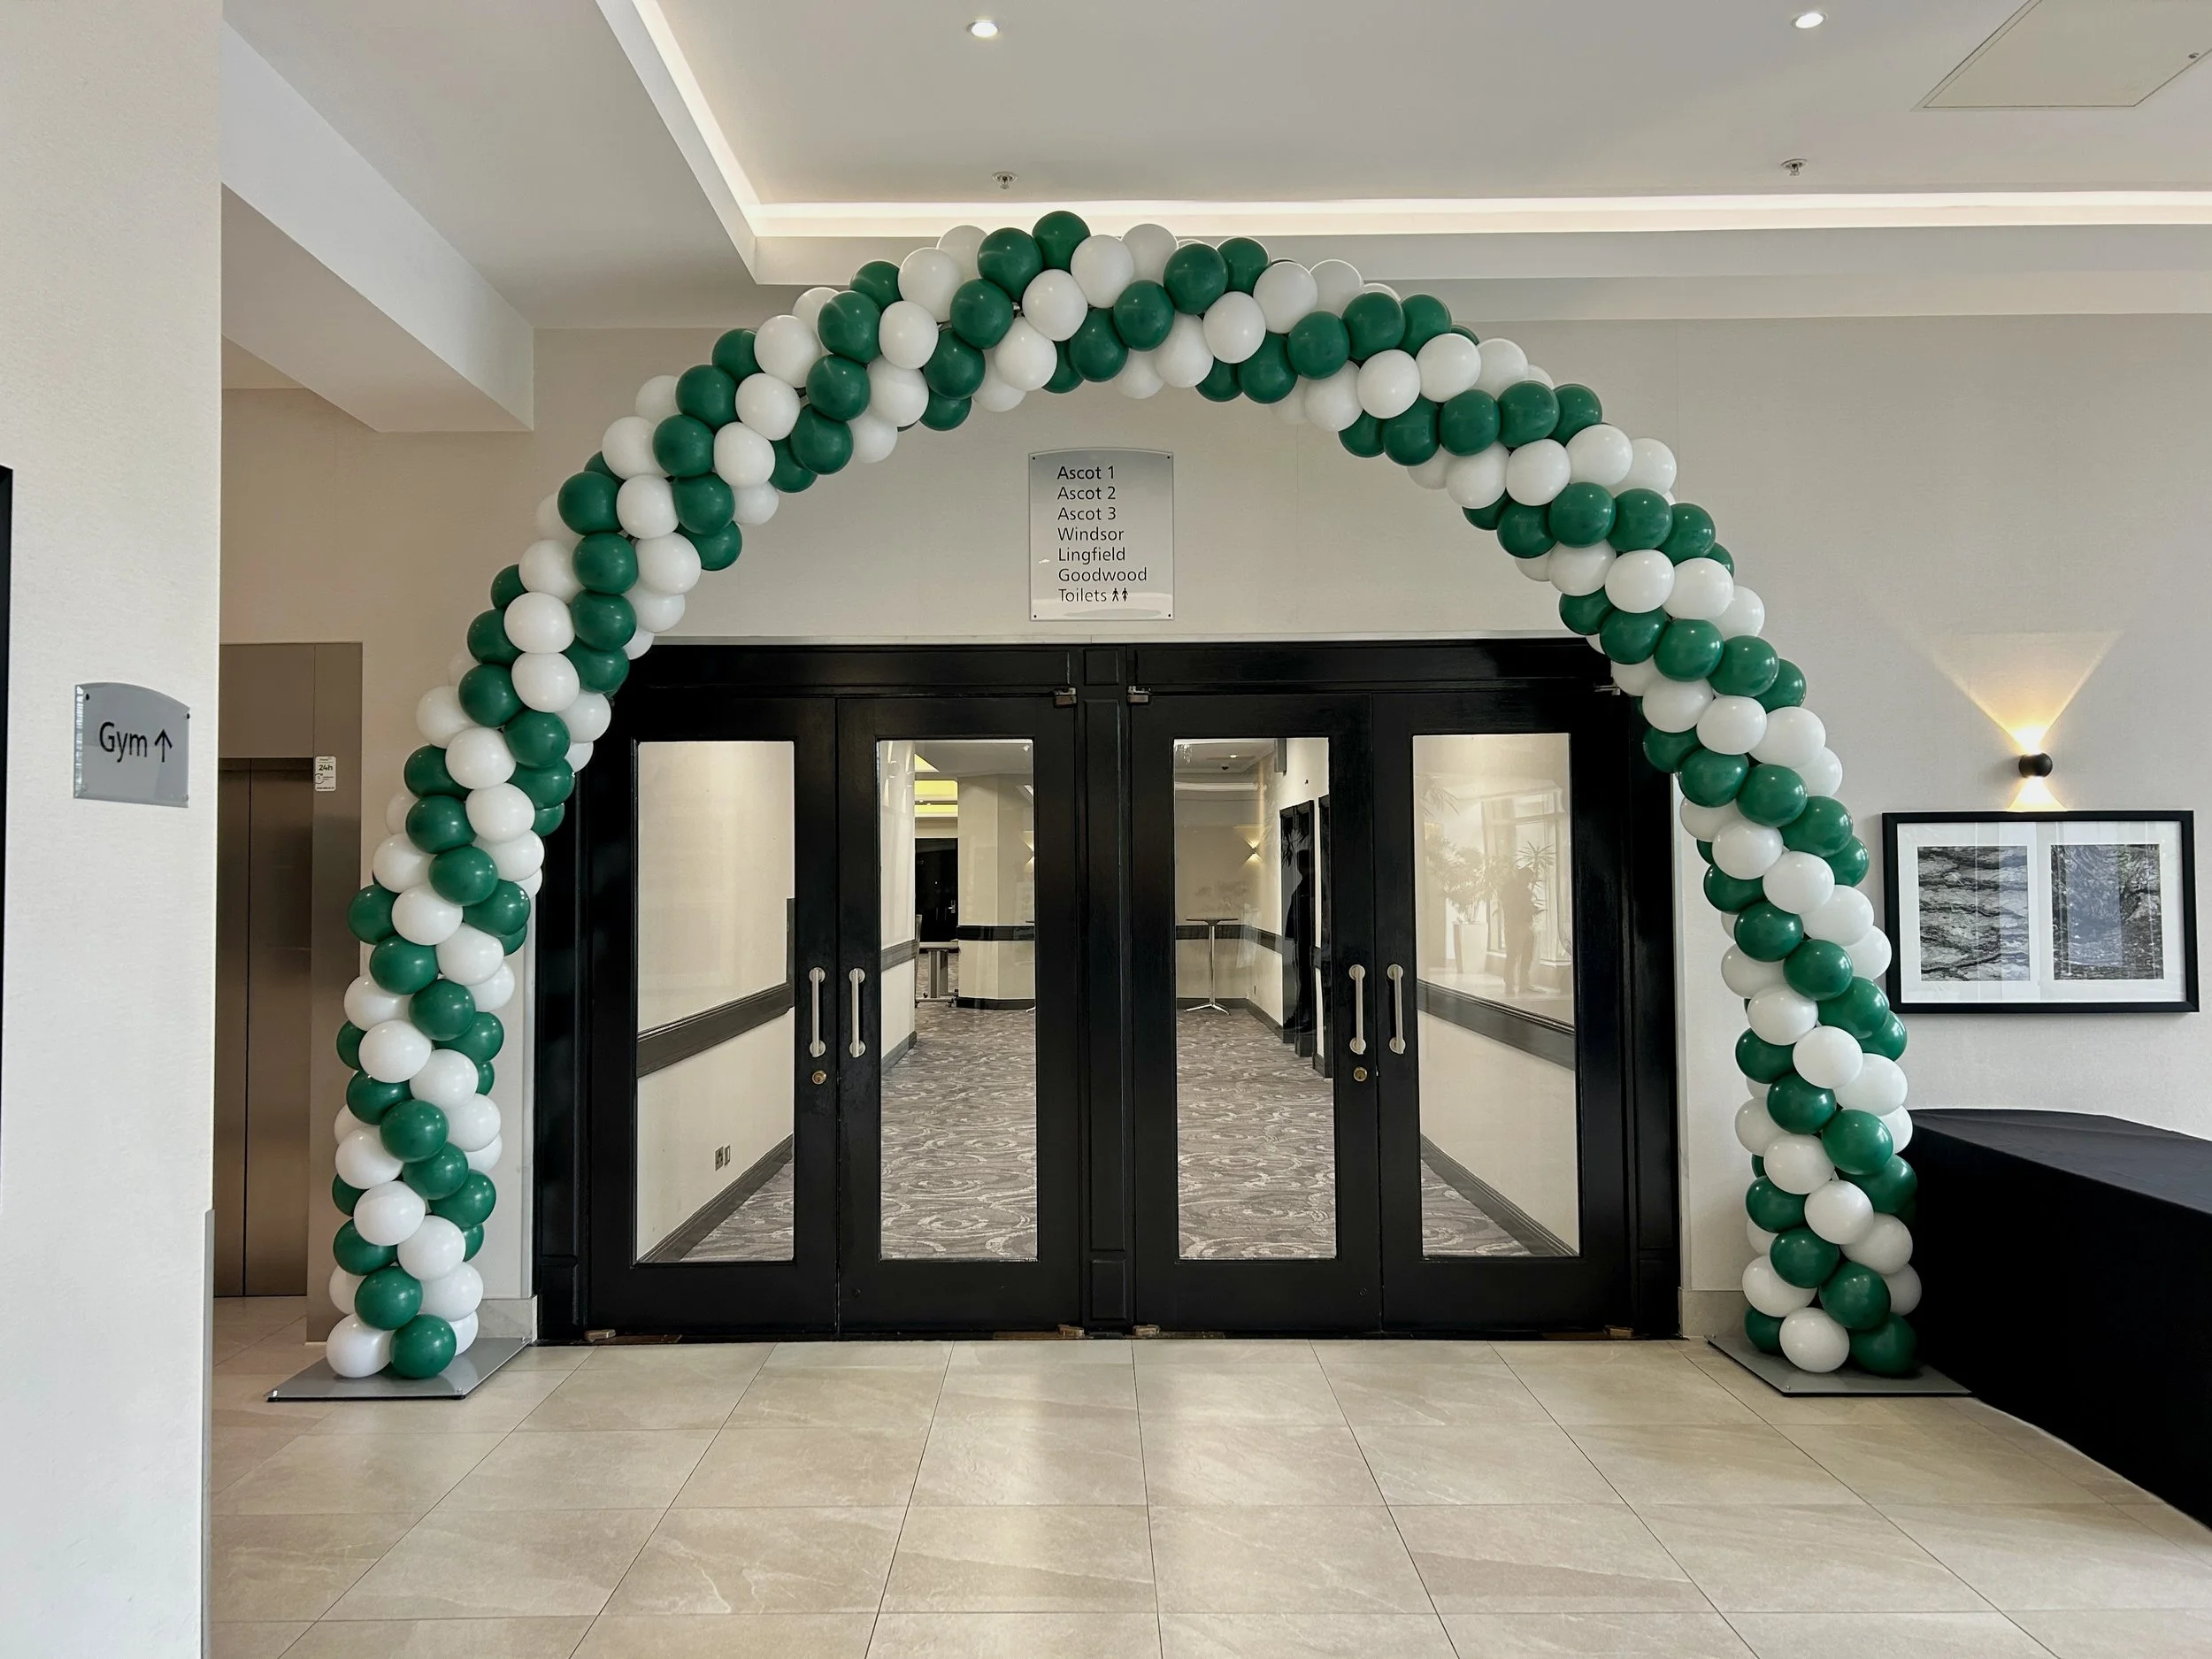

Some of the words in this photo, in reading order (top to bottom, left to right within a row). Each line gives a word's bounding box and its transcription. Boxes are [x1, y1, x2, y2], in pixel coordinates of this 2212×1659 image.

[1056, 465, 1102, 480] Ascot
[1109, 465, 1115, 480] 1
[1056, 486, 1102, 500] Ascot
[1107, 486, 1117, 500] 2
[1057, 507, 1102, 520] Ascot
[1107, 506, 1117, 520] 3
[1057, 526, 1125, 541] Windsor
[1058, 547, 1125, 565] Lingfield
[1058, 567, 1148, 581] Goodwood
[1058, 588, 1107, 603] Toilets
[99, 721, 148, 764] Gym
